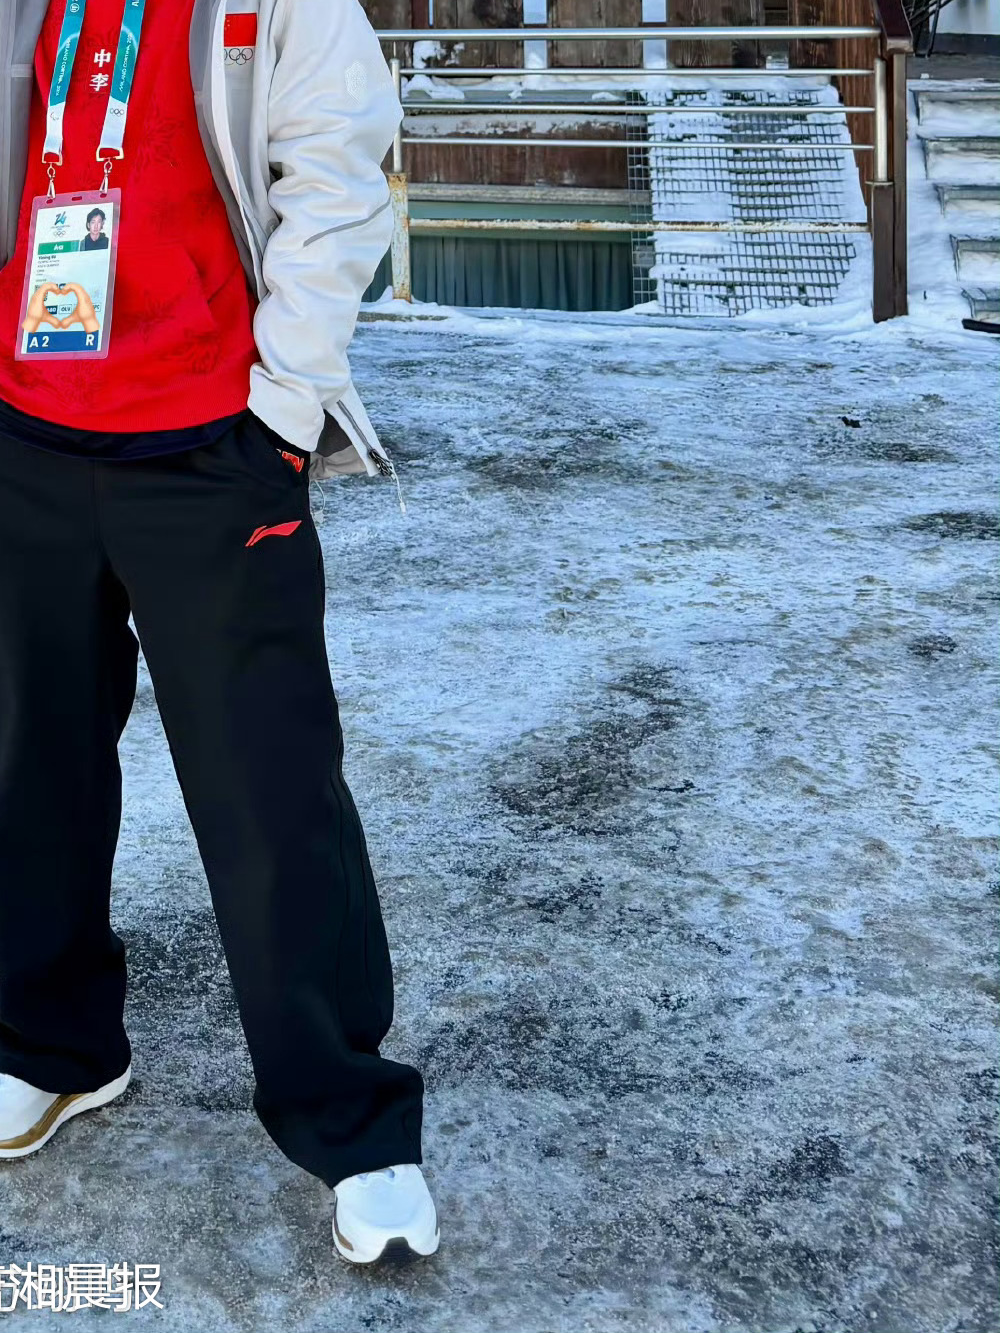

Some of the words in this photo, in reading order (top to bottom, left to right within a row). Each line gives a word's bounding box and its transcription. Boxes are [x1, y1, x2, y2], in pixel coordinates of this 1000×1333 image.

[29, 337, 39, 348] A
[42, 335, 49, 347] 2
[85, 334, 95, 346] R
